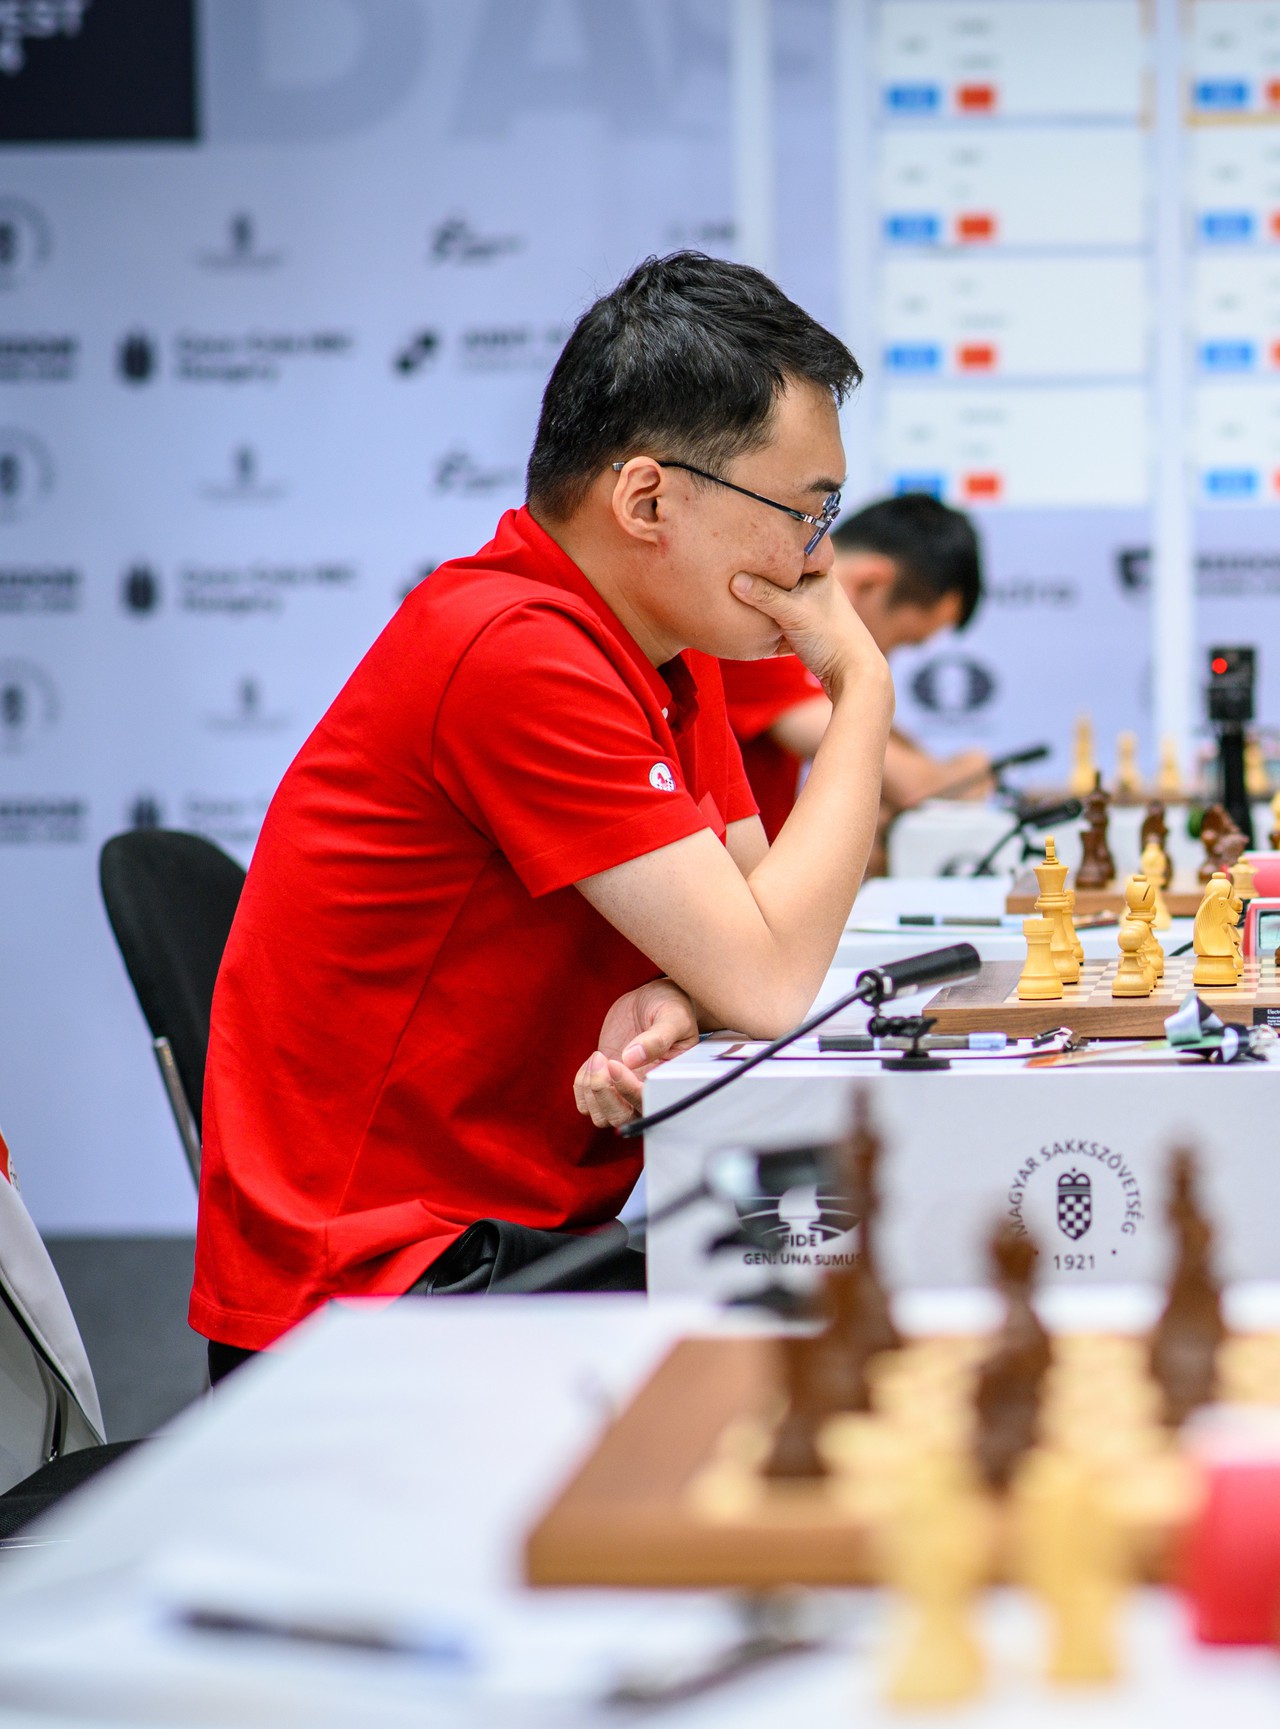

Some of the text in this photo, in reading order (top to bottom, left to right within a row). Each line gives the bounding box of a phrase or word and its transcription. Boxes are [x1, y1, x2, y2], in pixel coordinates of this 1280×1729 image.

[1008, 1138, 1144, 1238] MAGYAR SAKKSZÖVETSÉG
[781, 1233, 818, 1248] FIDE
[780, 1252, 812, 1265] UNA
[1054, 1254, 1096, 1271] 1921
